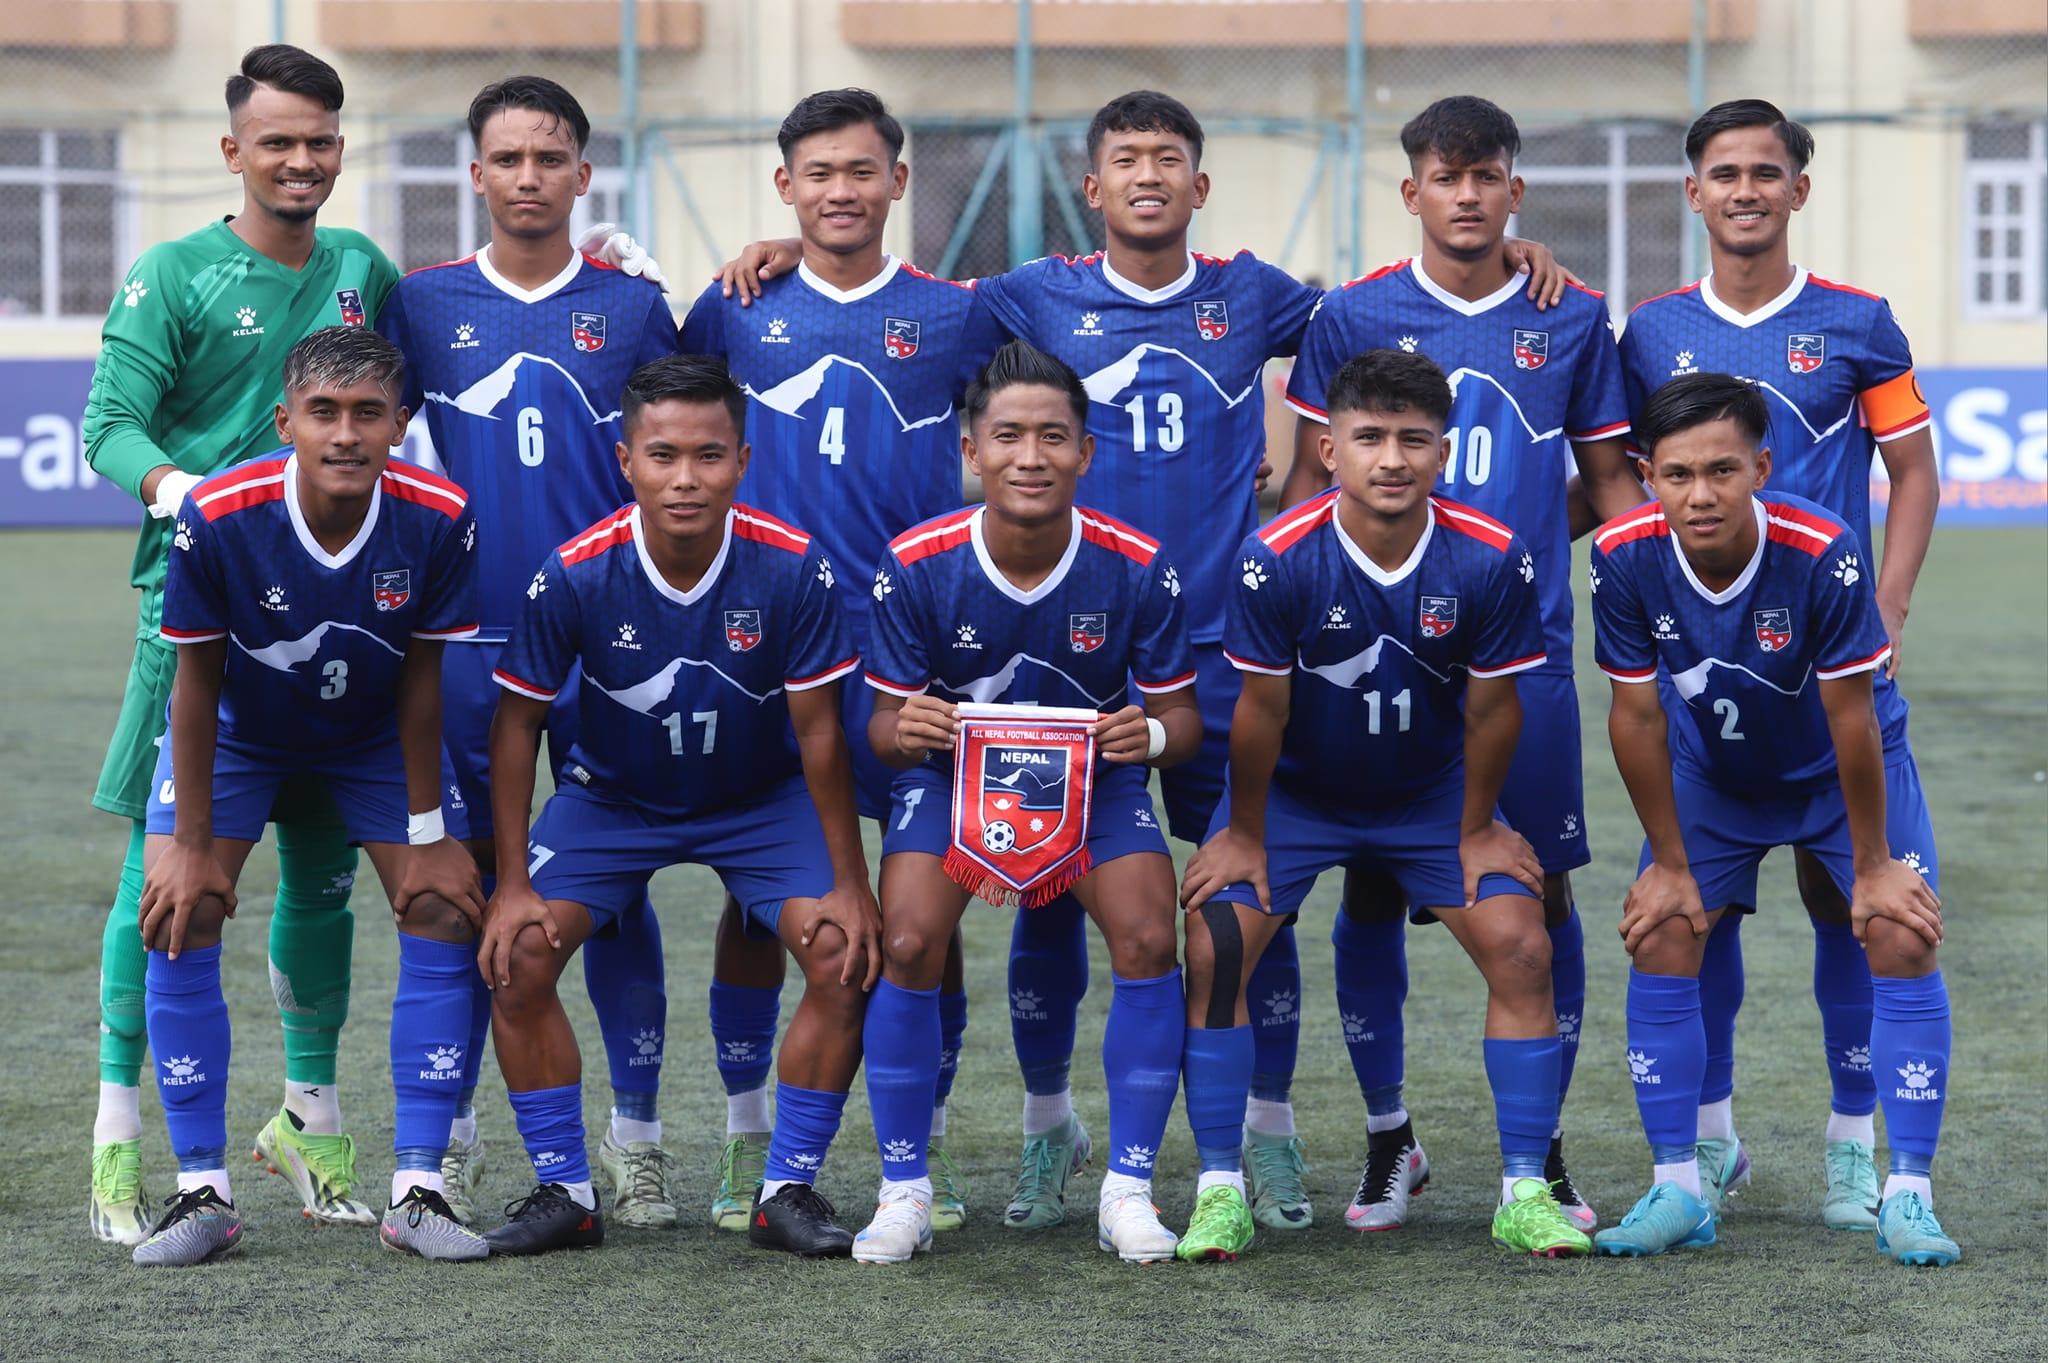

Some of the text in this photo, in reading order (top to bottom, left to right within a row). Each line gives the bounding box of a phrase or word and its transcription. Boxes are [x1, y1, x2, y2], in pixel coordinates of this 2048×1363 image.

[233, 327, 264, 336] KELME
[451, 340, 480, 349] KELME
[761, 335, 790, 343] KELME
[1671, 366, 1698, 376] KELME
[1125, 393, 1183, 453] 13
[517, 406, 545, 467] 6
[819, 407, 845, 465] 4
[1444, 426, 1492, 486] 10
[260, 600, 290, 611] KELME
[612, 641, 642, 650] KELME
[952, 642, 983, 650] KELME
[320, 660, 348, 700] 3
[1363, 689, 1411, 735] 11
[1713, 698, 1745, 740] 2
[661, 710, 718, 755] 17
[971, 730, 1085, 742] ALL NEPAL FOOTBALL ASSOCIATION
[1000, 752, 1050, 764] NEPAL
[720, 1053, 758, 1062] KELME
[163, 1073, 206, 1086] KELME
[1896, 1087, 1938, 1100] KELME
[534, 1154, 567, 1168] KELME
[884, 1153, 917, 1162] KELME
[1119, 1156, 1153, 1168] KELME
